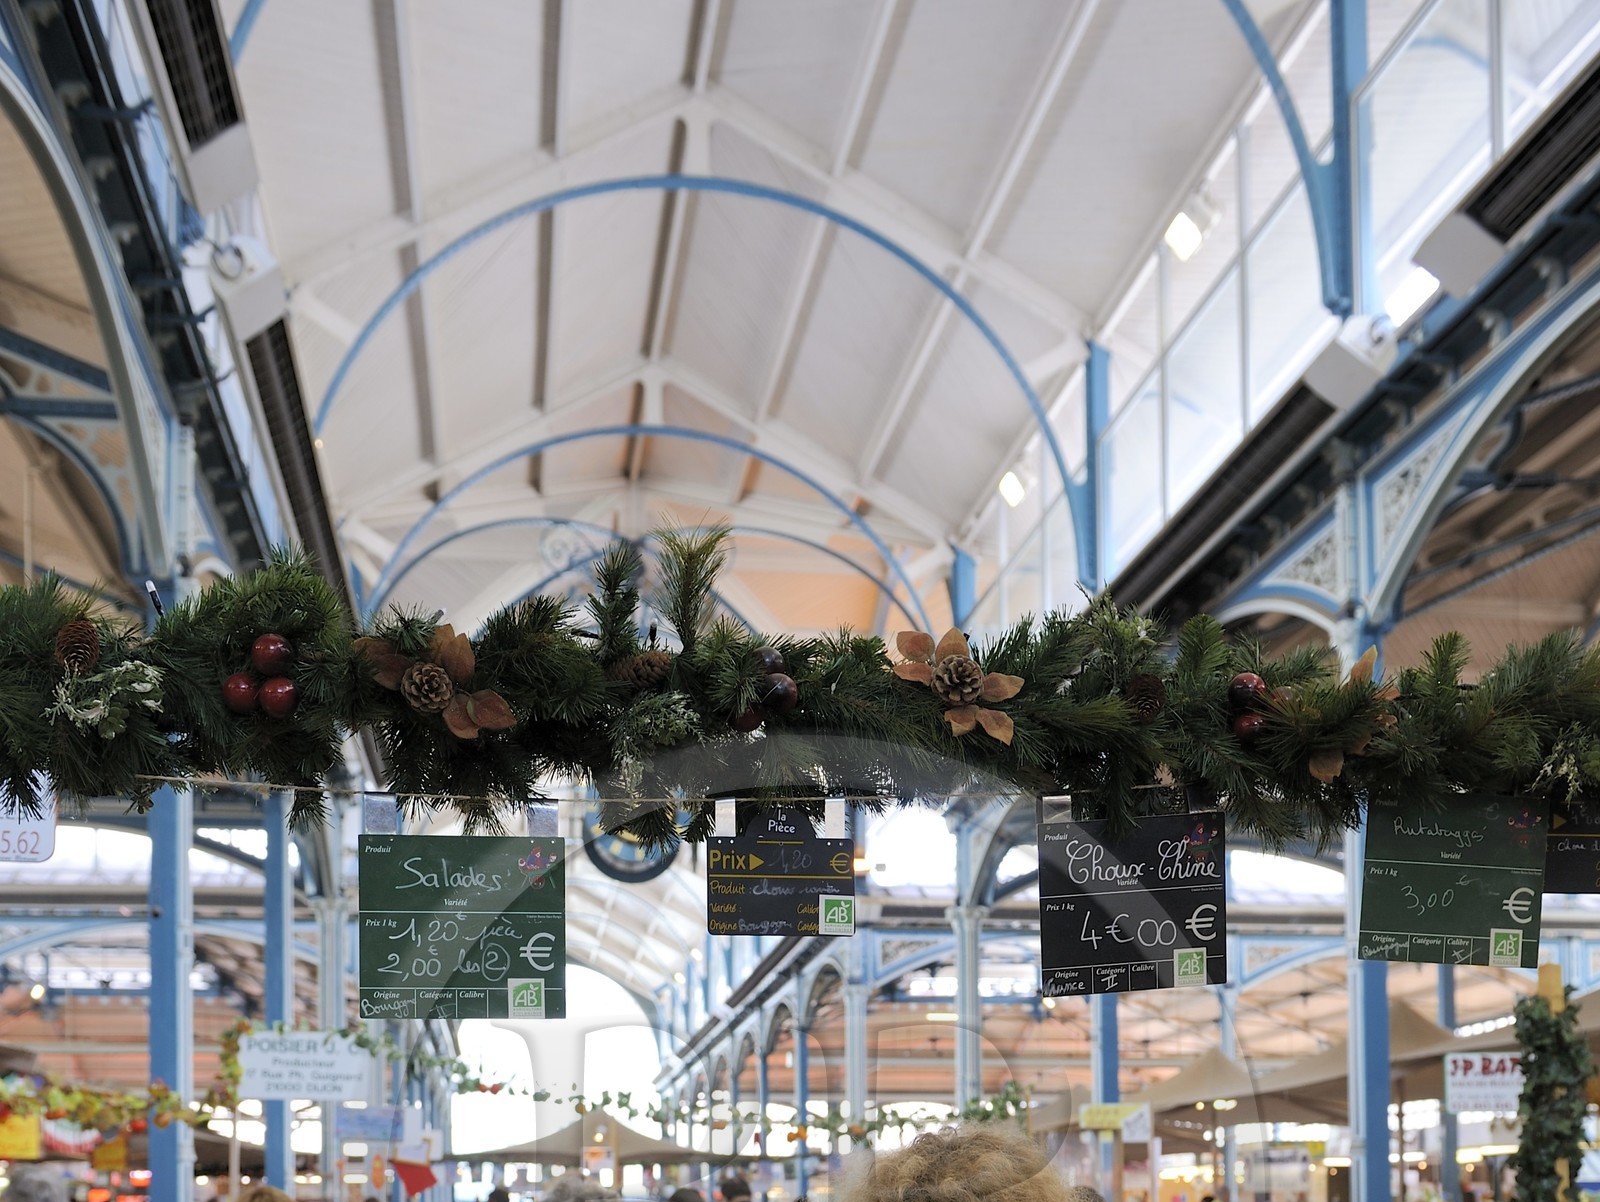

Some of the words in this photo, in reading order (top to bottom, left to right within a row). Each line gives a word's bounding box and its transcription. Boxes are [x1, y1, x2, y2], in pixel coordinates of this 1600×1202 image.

[778, 809, 787, 822] la
[768, 820, 796, 834] Pièce
[1044, 833, 1069, 841] Produit
[365, 845, 391, 854] Produit
[1440, 851, 1462, 860] Variété
[709, 850, 747, 871] Prix
[829, 852, 851, 874] €
[1065, 840, 1146, 885] Choux
[1157, 839, 1222, 881] Chine
[395, 857, 503, 893] Salades
[1369, 867, 1384, 876] Prix
[1389, 868, 1398, 877] kg
[709, 880, 746, 895] Produit
[1116, 878, 1139, 887] Variété
[444, 898, 468, 907] Variété
[709, 903, 737, 913] Variété
[796, 903, 820, 914] Calibr
[1066, 903, 1075, 911] kg
[1400, 885, 1454, 916] 3,00
[1502, 887, 1535, 924] €
[825, 906, 849, 923] AB
[365, 919, 381, 928] Prix
[388, 919, 397, 930] kg
[709, 920, 738, 934] Origine
[1185, 903, 1218, 941] €
[1372, 935, 1396, 943] Origine
[1412, 936, 1442, 945] Catégorie
[1447, 938, 1470, 946] Calibre
[1494, 939, 1516, 955] AB
[519, 932, 556, 972] €
[377, 952, 442, 982] 2,00
[1054, 971, 1079, 980] Origine
[1096, 966, 1127, 976] Catégorie
[1131, 964, 1155, 972] Calibre
[1179, 958, 1201, 976] AB
[373, 990, 400, 1000] Origine
[419, 990, 453, 1000] Catégorie
[459, 989, 485, 999] Calibre
[514, 989, 538, 1007] AB
[261, 1069, 283, 1079] Rue
[306, 1082, 343, 1092] DIJON
